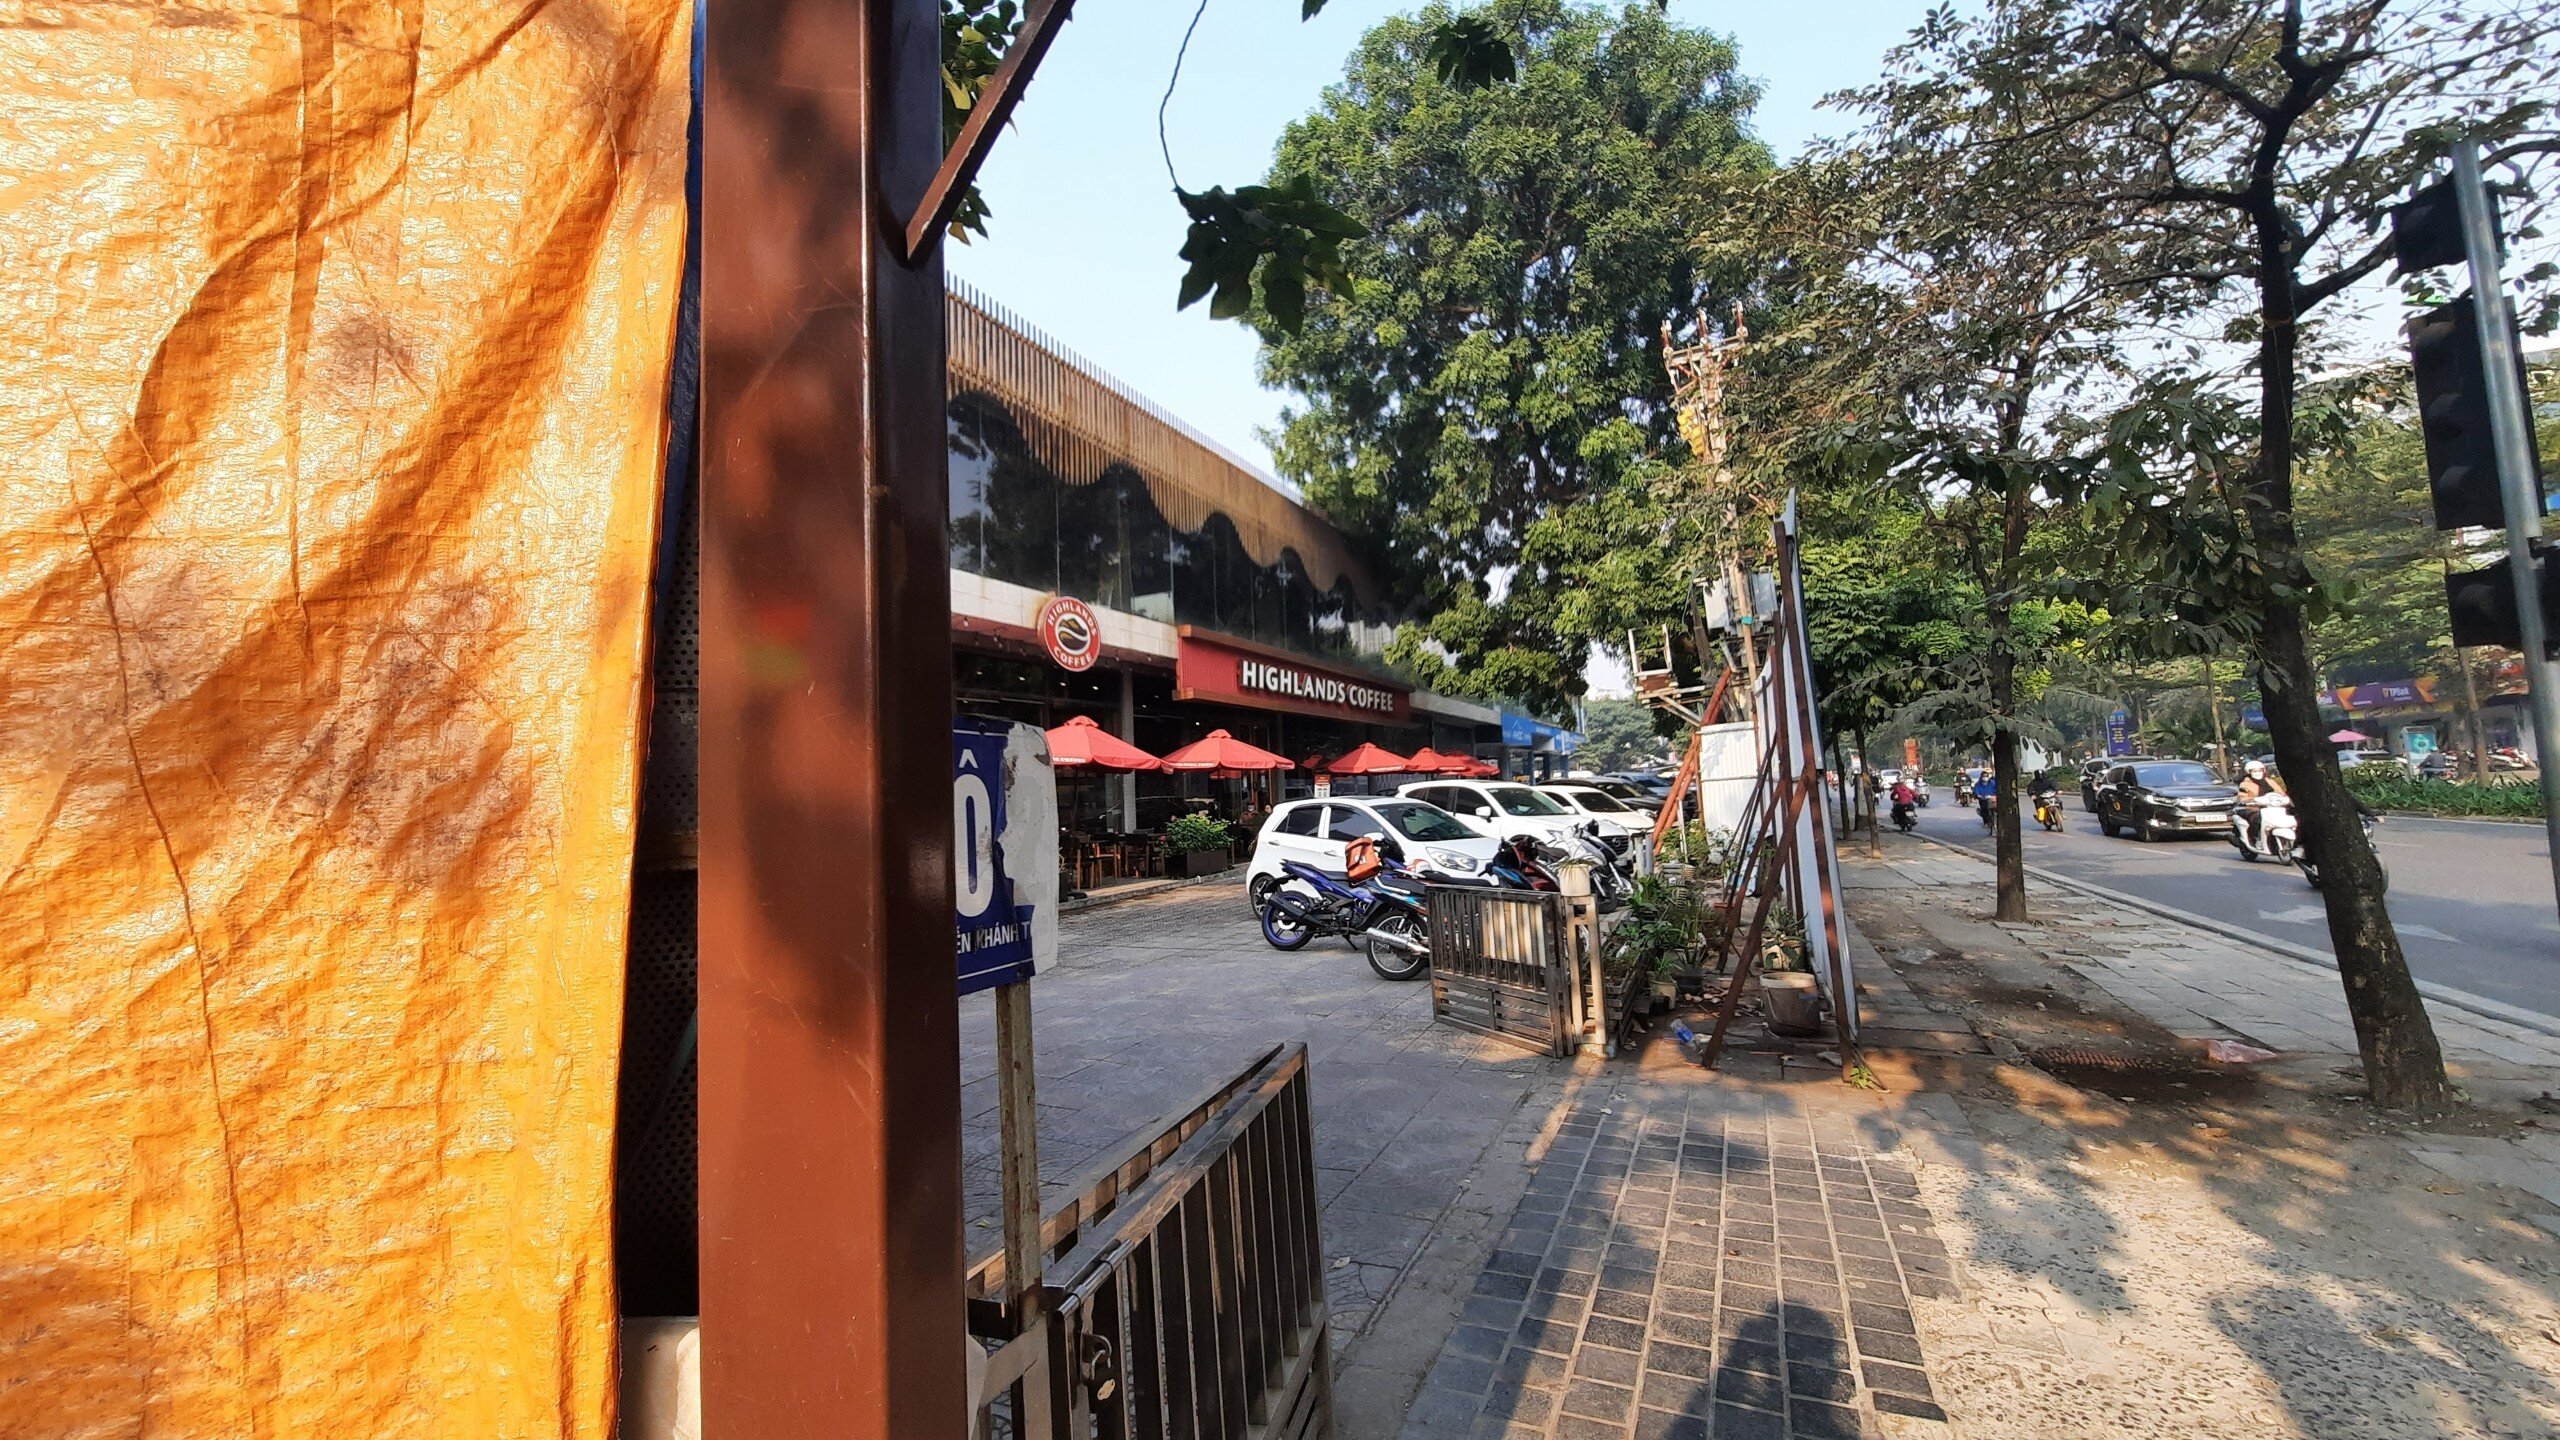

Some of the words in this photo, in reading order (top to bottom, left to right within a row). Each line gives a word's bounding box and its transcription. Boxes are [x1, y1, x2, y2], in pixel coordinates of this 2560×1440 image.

[1047, 601, 1098, 636] HIGHLANDS
[1053, 646, 1093, 667] COFFEE
[1242, 660, 1346, 704] HIGHLANDS
[1349, 685, 1394, 712] COFFEE
[976, 921, 1020, 949] KHÁNH
